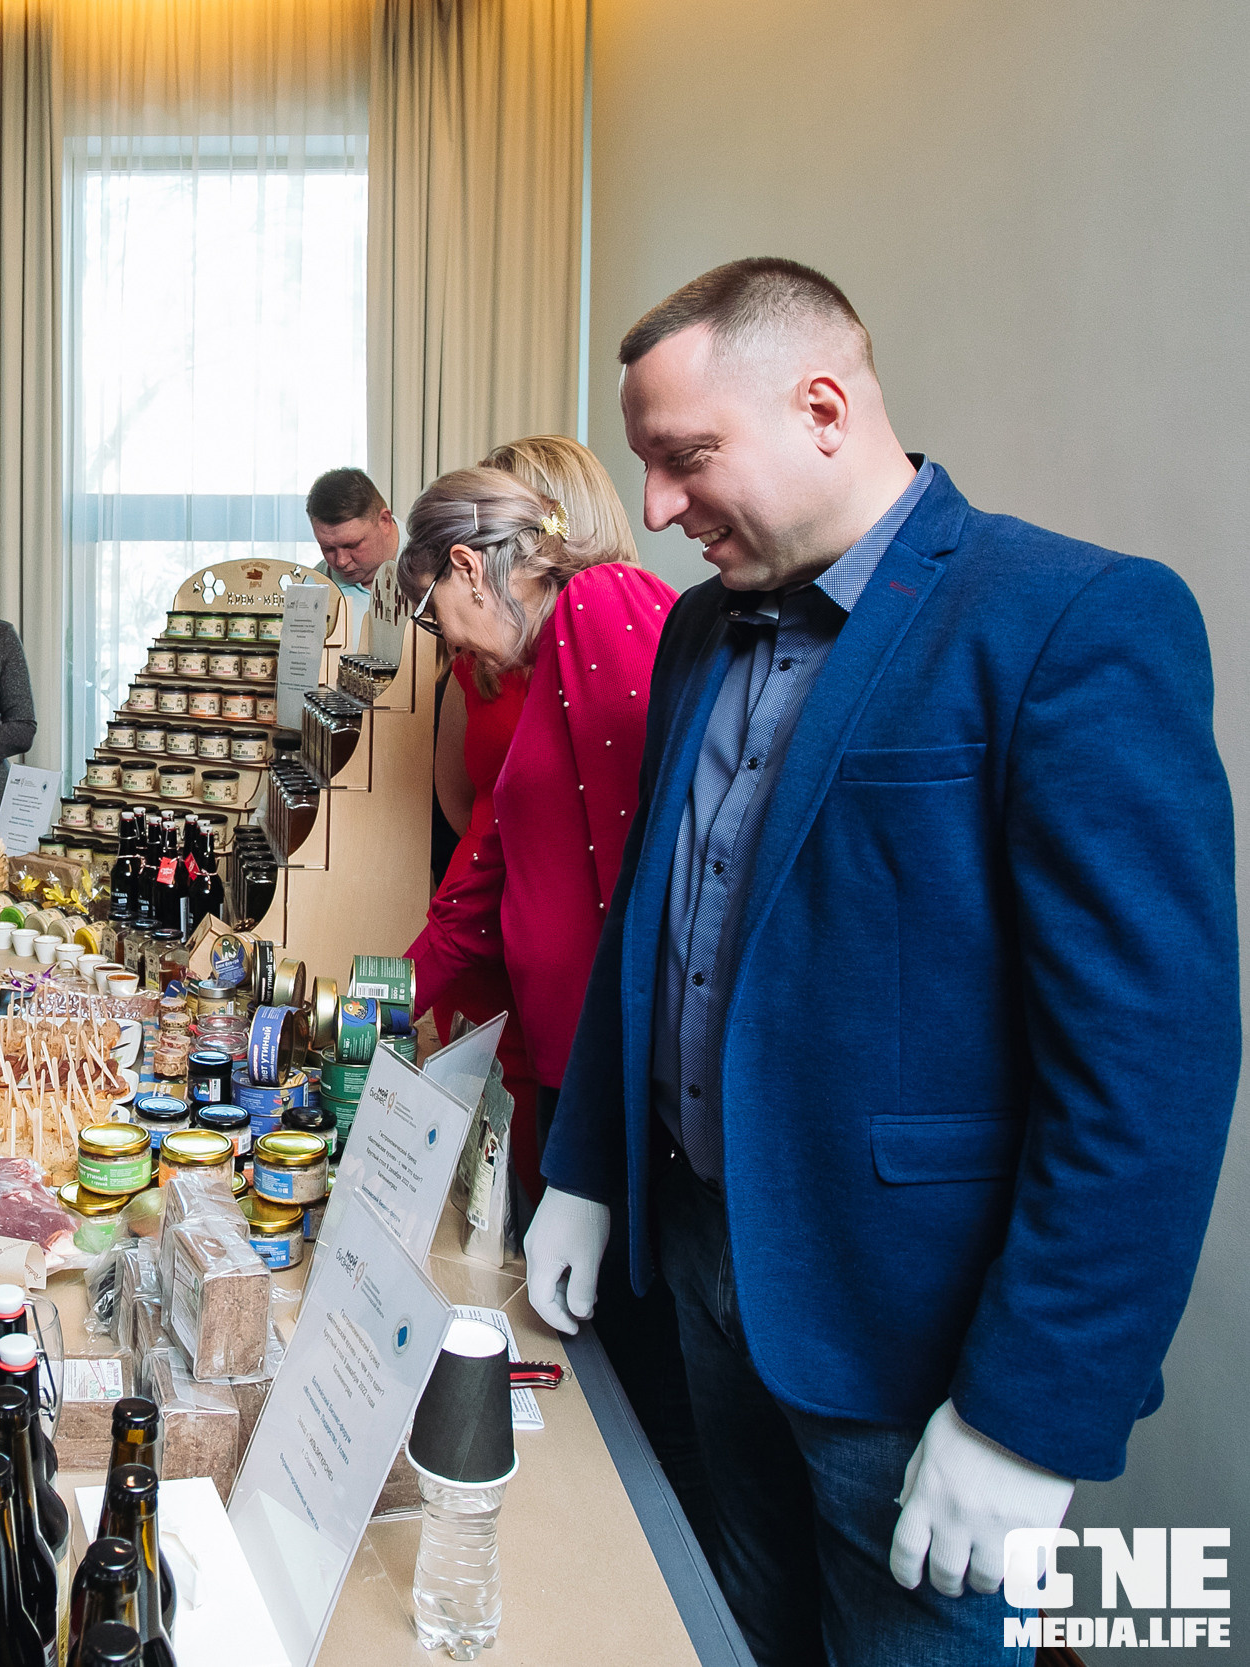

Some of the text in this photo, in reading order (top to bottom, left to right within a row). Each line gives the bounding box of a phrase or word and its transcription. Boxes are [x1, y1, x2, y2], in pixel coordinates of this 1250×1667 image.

[261, 1026, 273, 1065] утиный
[369, 1087, 387, 1105] бизнес
[377, 1085, 389, 1098] мой
[86, 1172, 108, 1182] утиный
[336, 1247, 354, 1277] бизнес
[346, 1248, 357, 1267] мой
[340, 1309, 380, 1368] Гастрономический бренд
[323, 1328, 336, 1350] Круглый
[345, 1361, 358, 1384] декабря
[358, 1381, 367, 1394] 2022
[365, 1394, 375, 1408] года
[332, 1364, 352, 1397] Калининград
[312, 1376, 329, 1405] Балтийский
